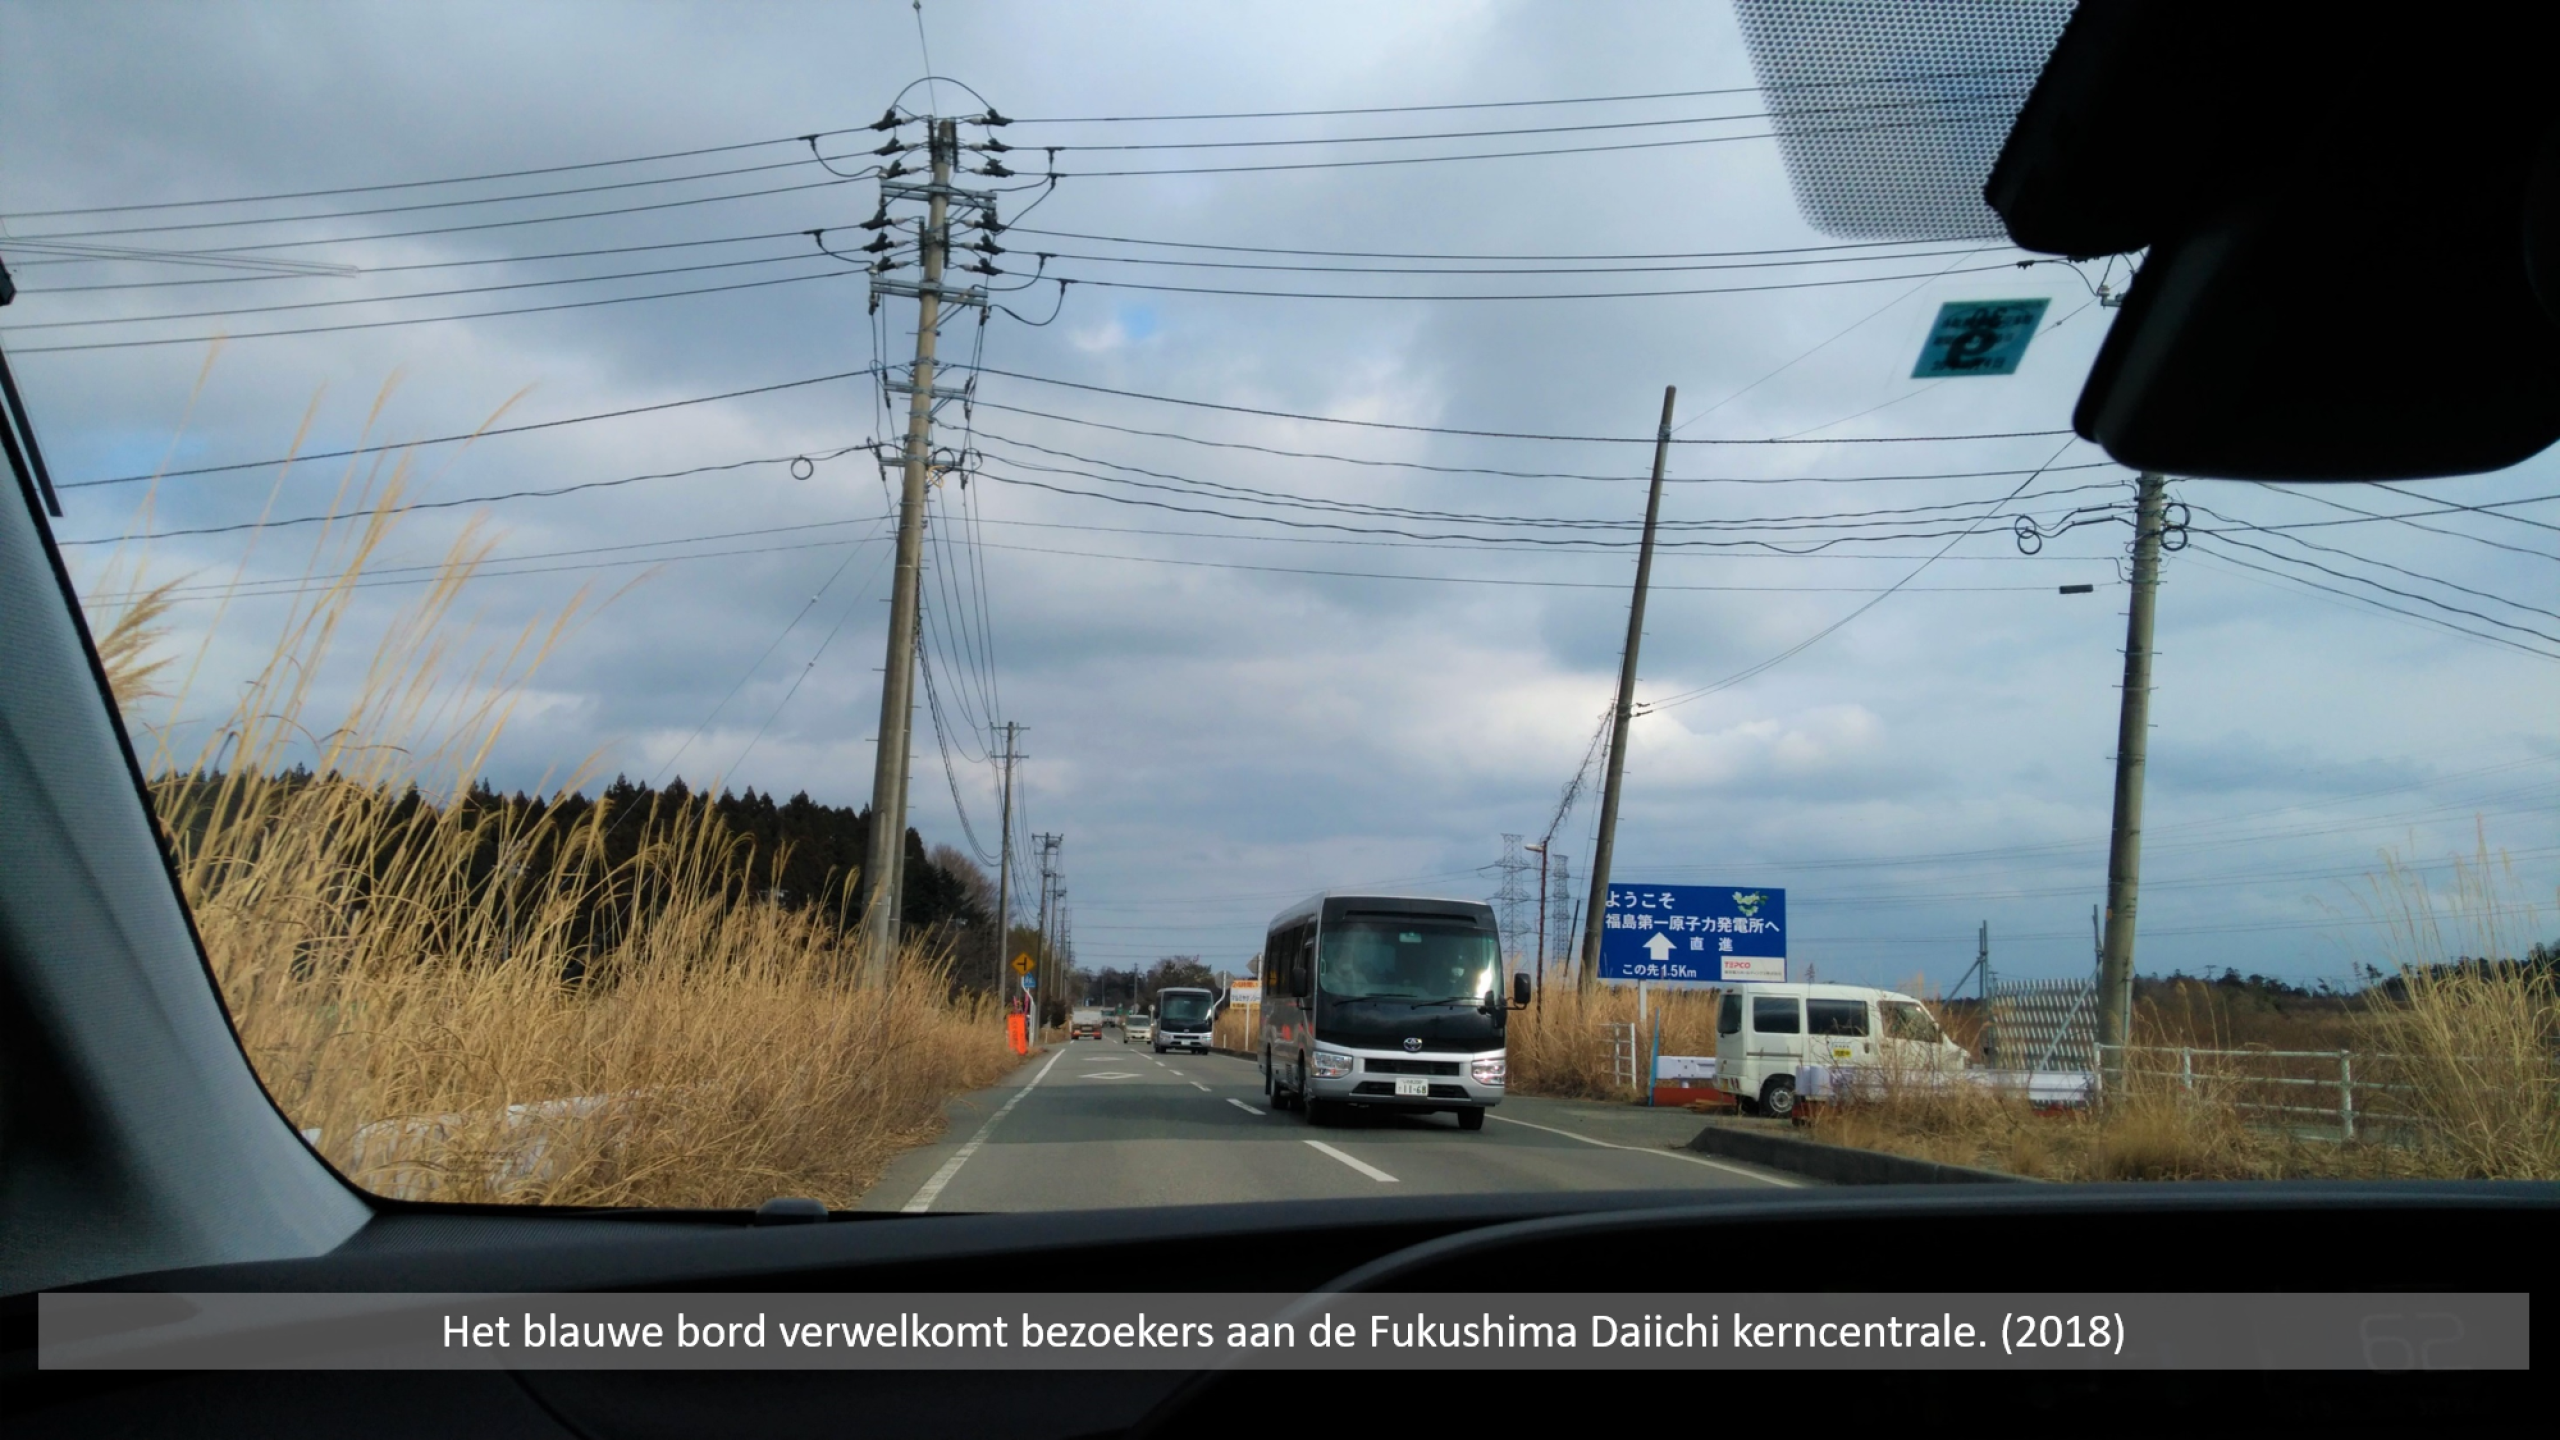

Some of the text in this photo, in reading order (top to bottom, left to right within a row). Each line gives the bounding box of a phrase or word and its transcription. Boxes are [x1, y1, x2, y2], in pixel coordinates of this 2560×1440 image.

[1605, 890, 1675, 910] ようこそ
[1605, 913, 1780, 934] 福島第一原子力発電所へ
[1724, 961, 1751, 969] TEPCO
